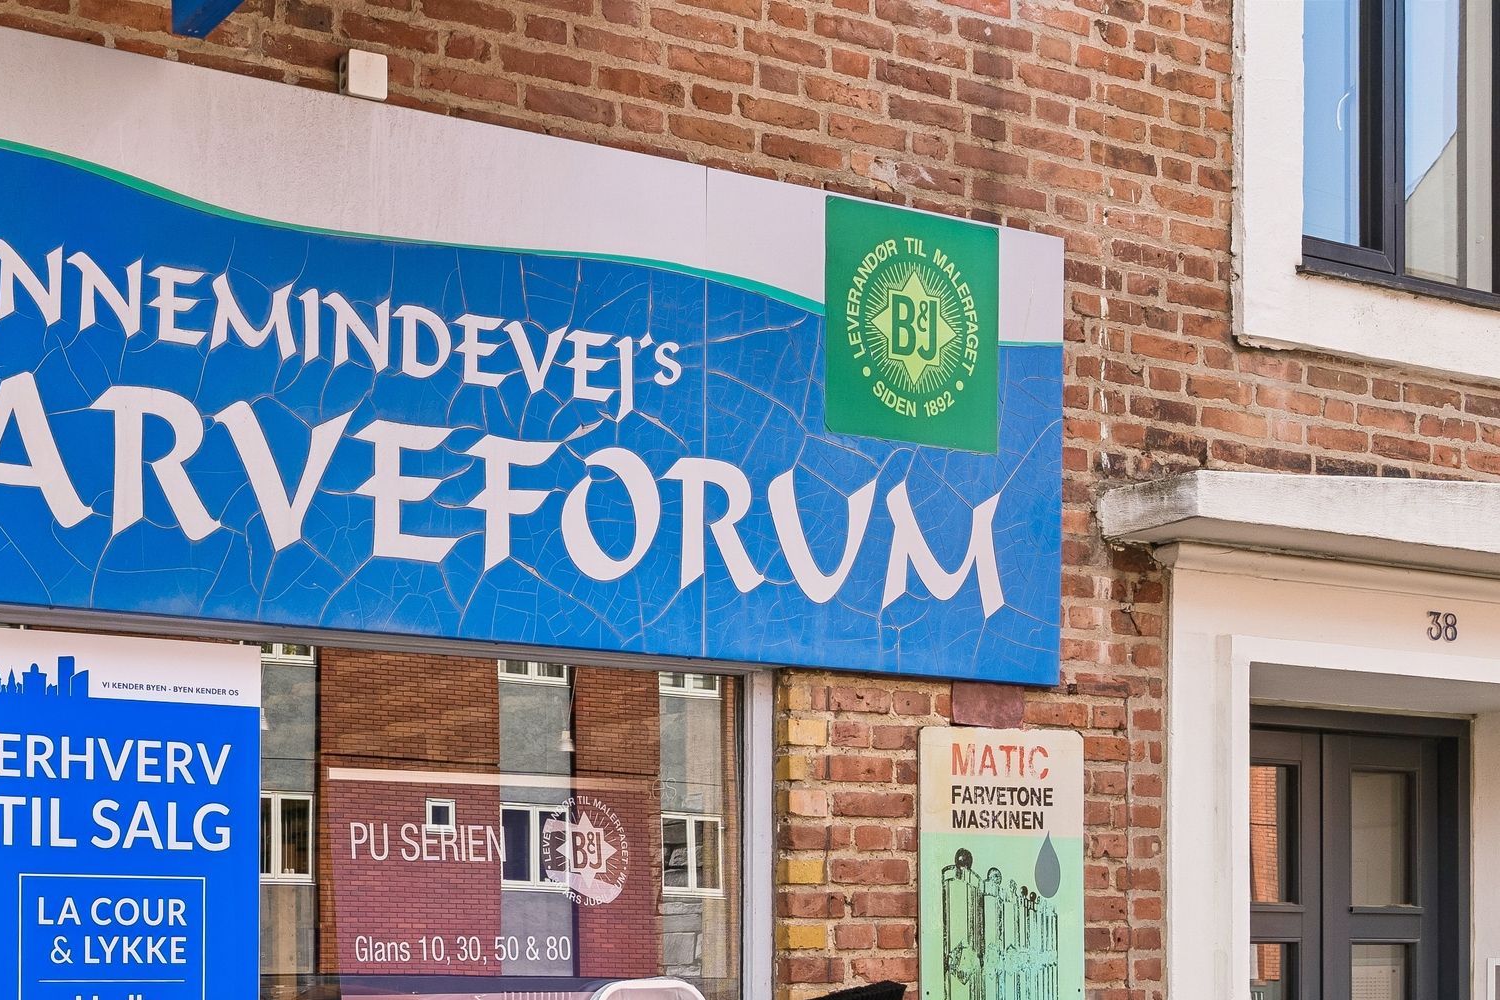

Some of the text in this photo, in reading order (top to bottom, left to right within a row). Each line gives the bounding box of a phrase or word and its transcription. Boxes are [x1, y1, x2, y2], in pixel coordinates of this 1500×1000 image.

[846, 237, 979, 376] LEVERANDØR TIL MALERFAGET
[891, 294, 938, 362] B&J
[872, 380, 956, 418] SIDEN 1892
[1426, 611, 1458, 641] 38
[102, 681, 110, 689] VI
[111, 682, 144, 691] KENDER
[146, 683, 167, 692] BYEN
[173, 685, 194, 693] BYEN
[195, 686, 227, 695] KENDER
[228, 688, 239, 696] OS
[951, 743, 1049, 780] MATIC
[951, 785, 1053, 806] FARVETONE
[90, 799, 231, 852] SALG
[577, 795, 591, 805] TIL
[593, 798, 629, 864] MALERFAGET
[952, 810, 1044, 829] MASKINEN
[350, 822, 507, 862] PU SERIEN
[38, 896, 188, 927] LA COUR
[50, 935, 188, 964] & LYKKE
[355, 935, 571, 965] Glans 10, 30, 50 & 80
